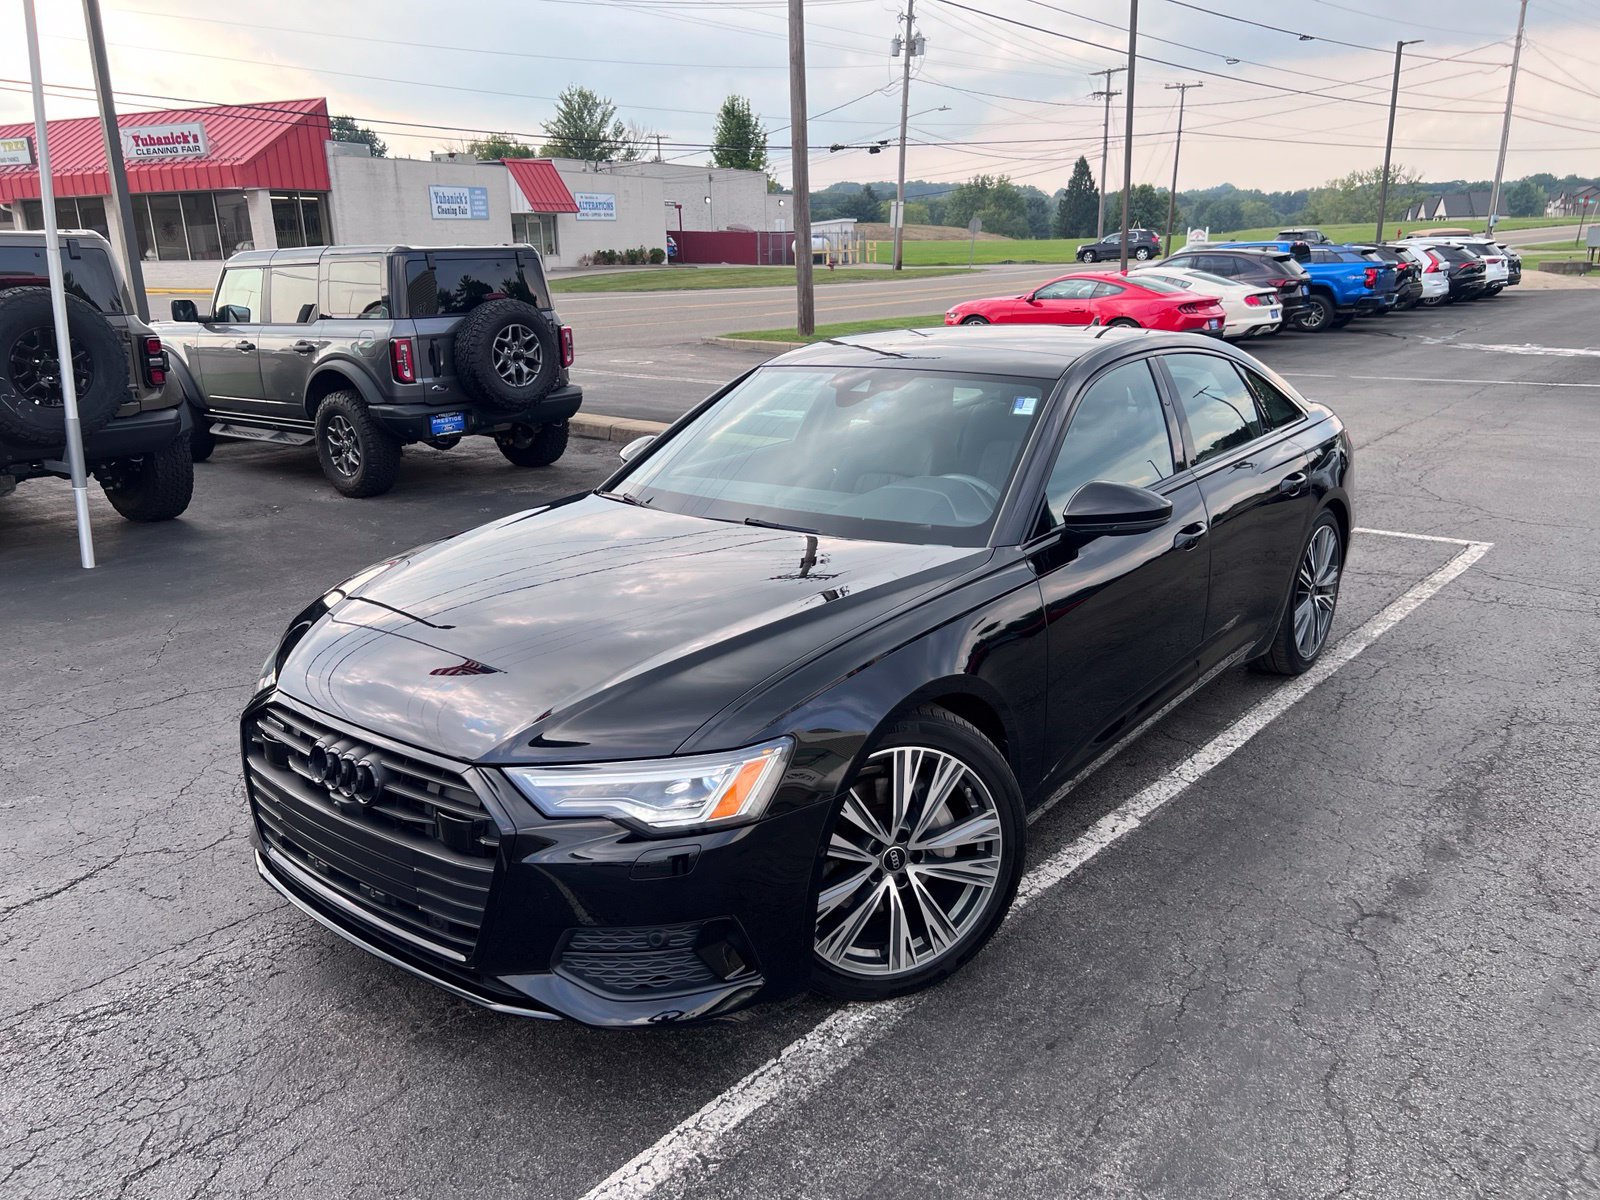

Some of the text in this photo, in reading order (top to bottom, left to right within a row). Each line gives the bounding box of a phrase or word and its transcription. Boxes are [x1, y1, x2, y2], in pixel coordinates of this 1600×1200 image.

[132, 131, 200, 147] Yuhanick's
[136, 145, 202, 156] CLEANING FAIR
[434, 191, 468, 204] Yuhanick's
[437, 205, 458, 216] Cleaning
[459, 205, 468, 215] Fair
[579, 201, 614, 211] ALTERATIONS
[432, 415, 462, 424] PRESTIGE
